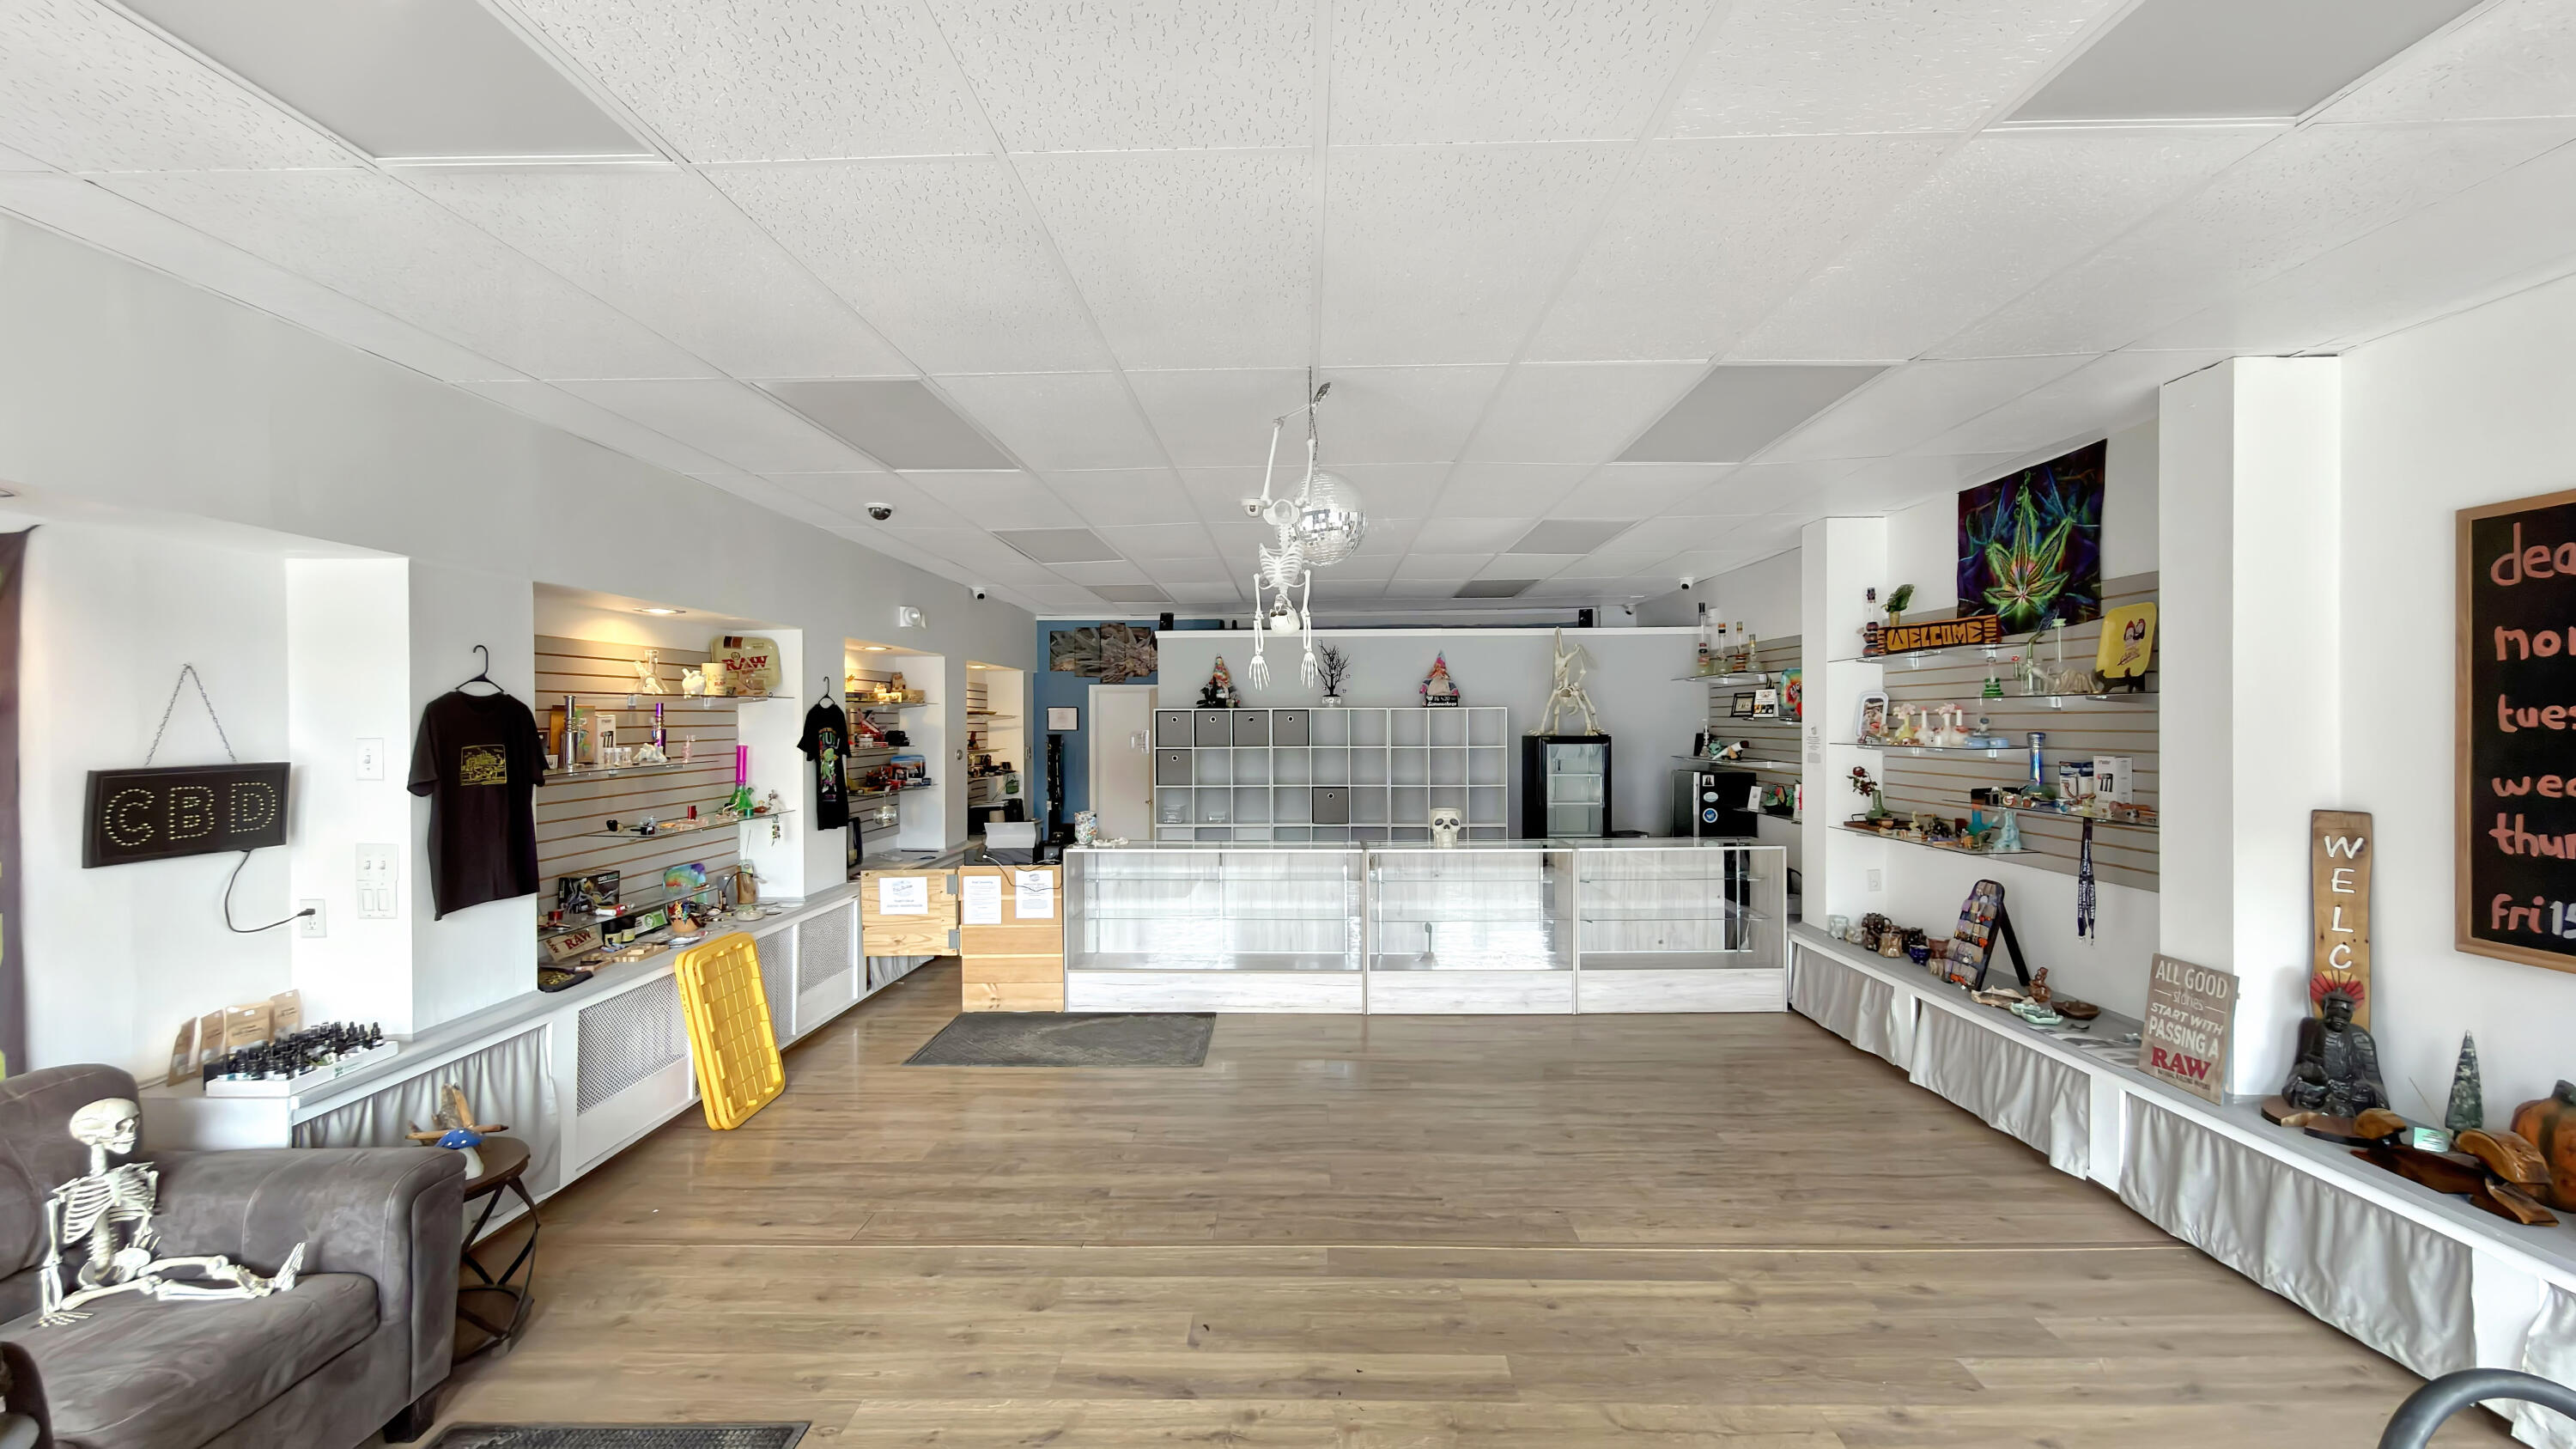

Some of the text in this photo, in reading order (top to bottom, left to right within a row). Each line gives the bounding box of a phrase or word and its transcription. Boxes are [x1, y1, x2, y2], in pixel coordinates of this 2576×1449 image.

[1886, 621, 1983, 651] WELCOME
[722, 655, 769, 671] RAW
[104, 782, 276, 847] CBD
[2324, 835, 2364, 969] WELC
[2492, 893, 2544, 934] fri
[563, 929, 592, 950] RAW
[2155, 959, 2227, 999] ALL GOOD
[2172, 989, 2204, 1011] stories
[2150, 1002, 2224, 1036] START WITH
[2148, 1015, 2219, 1059] PASSING A
[2151, 1046, 2211, 1080] RAW
